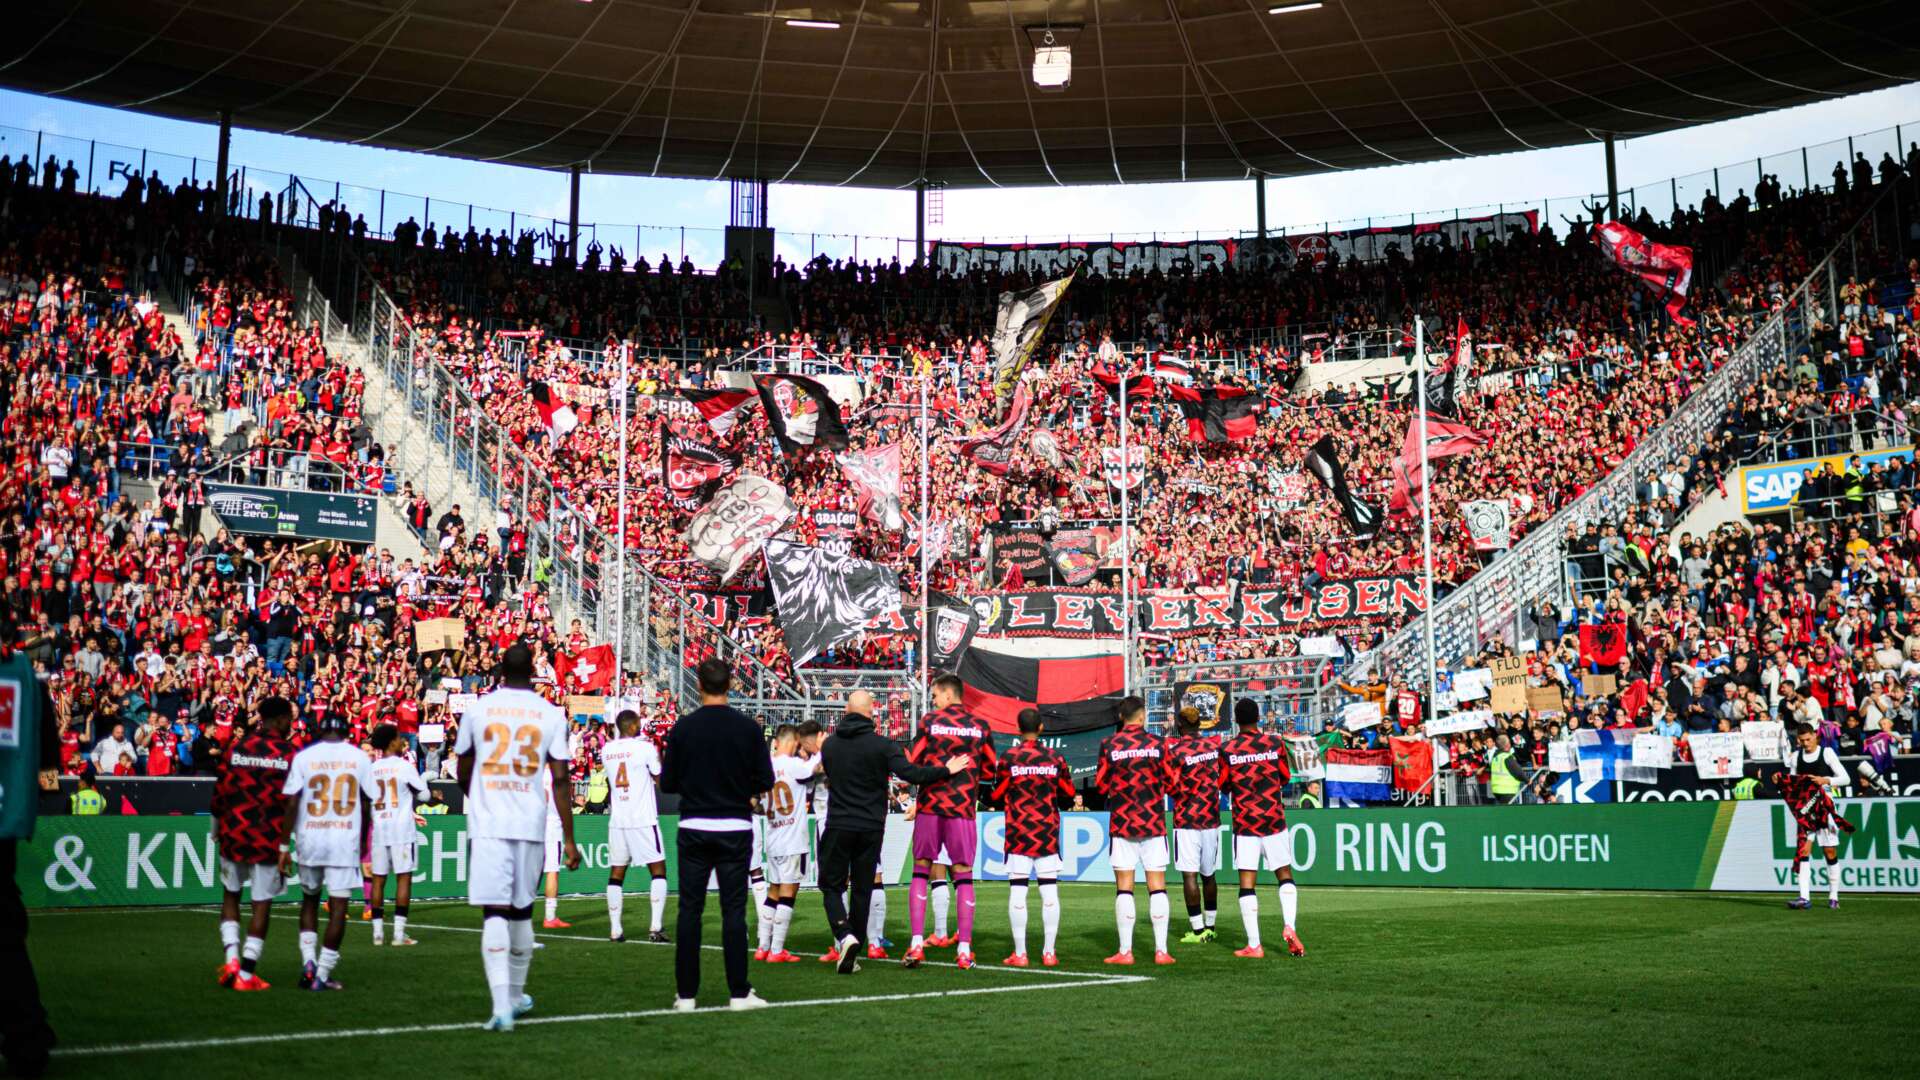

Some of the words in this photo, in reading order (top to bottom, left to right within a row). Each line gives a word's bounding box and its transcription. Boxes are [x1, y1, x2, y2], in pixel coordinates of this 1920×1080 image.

[1746, 471, 1802, 503] SAP
[243, 501, 263, 511] pre
[243, 509, 269, 519] zero
[278, 512, 299, 521] Arena
[1496, 656, 1521, 671] FLO
[1398, 698, 1416, 716] 20
[930, 724, 982, 738] Barmenia
[481, 722, 543, 778] 23
[1111, 748, 1160, 761] Barmenia
[1185, 750, 1219, 766] Barmeni
[1229, 750, 1278, 765] Barmenia
[231, 753, 288, 770] Barmenia
[1074, 765, 1098, 774] Aren
[615, 761, 630, 793] 4
[1011, 765, 1058, 777] Barmenia
[306, 773, 359, 817] 30
[1771, 801, 1891, 860] LM
[983, 815, 1104, 877] SP
[1336, 821, 1446, 873] RING
[1482, 834, 1610, 863] ILSHOFEN
[44, 835, 97, 892] &
